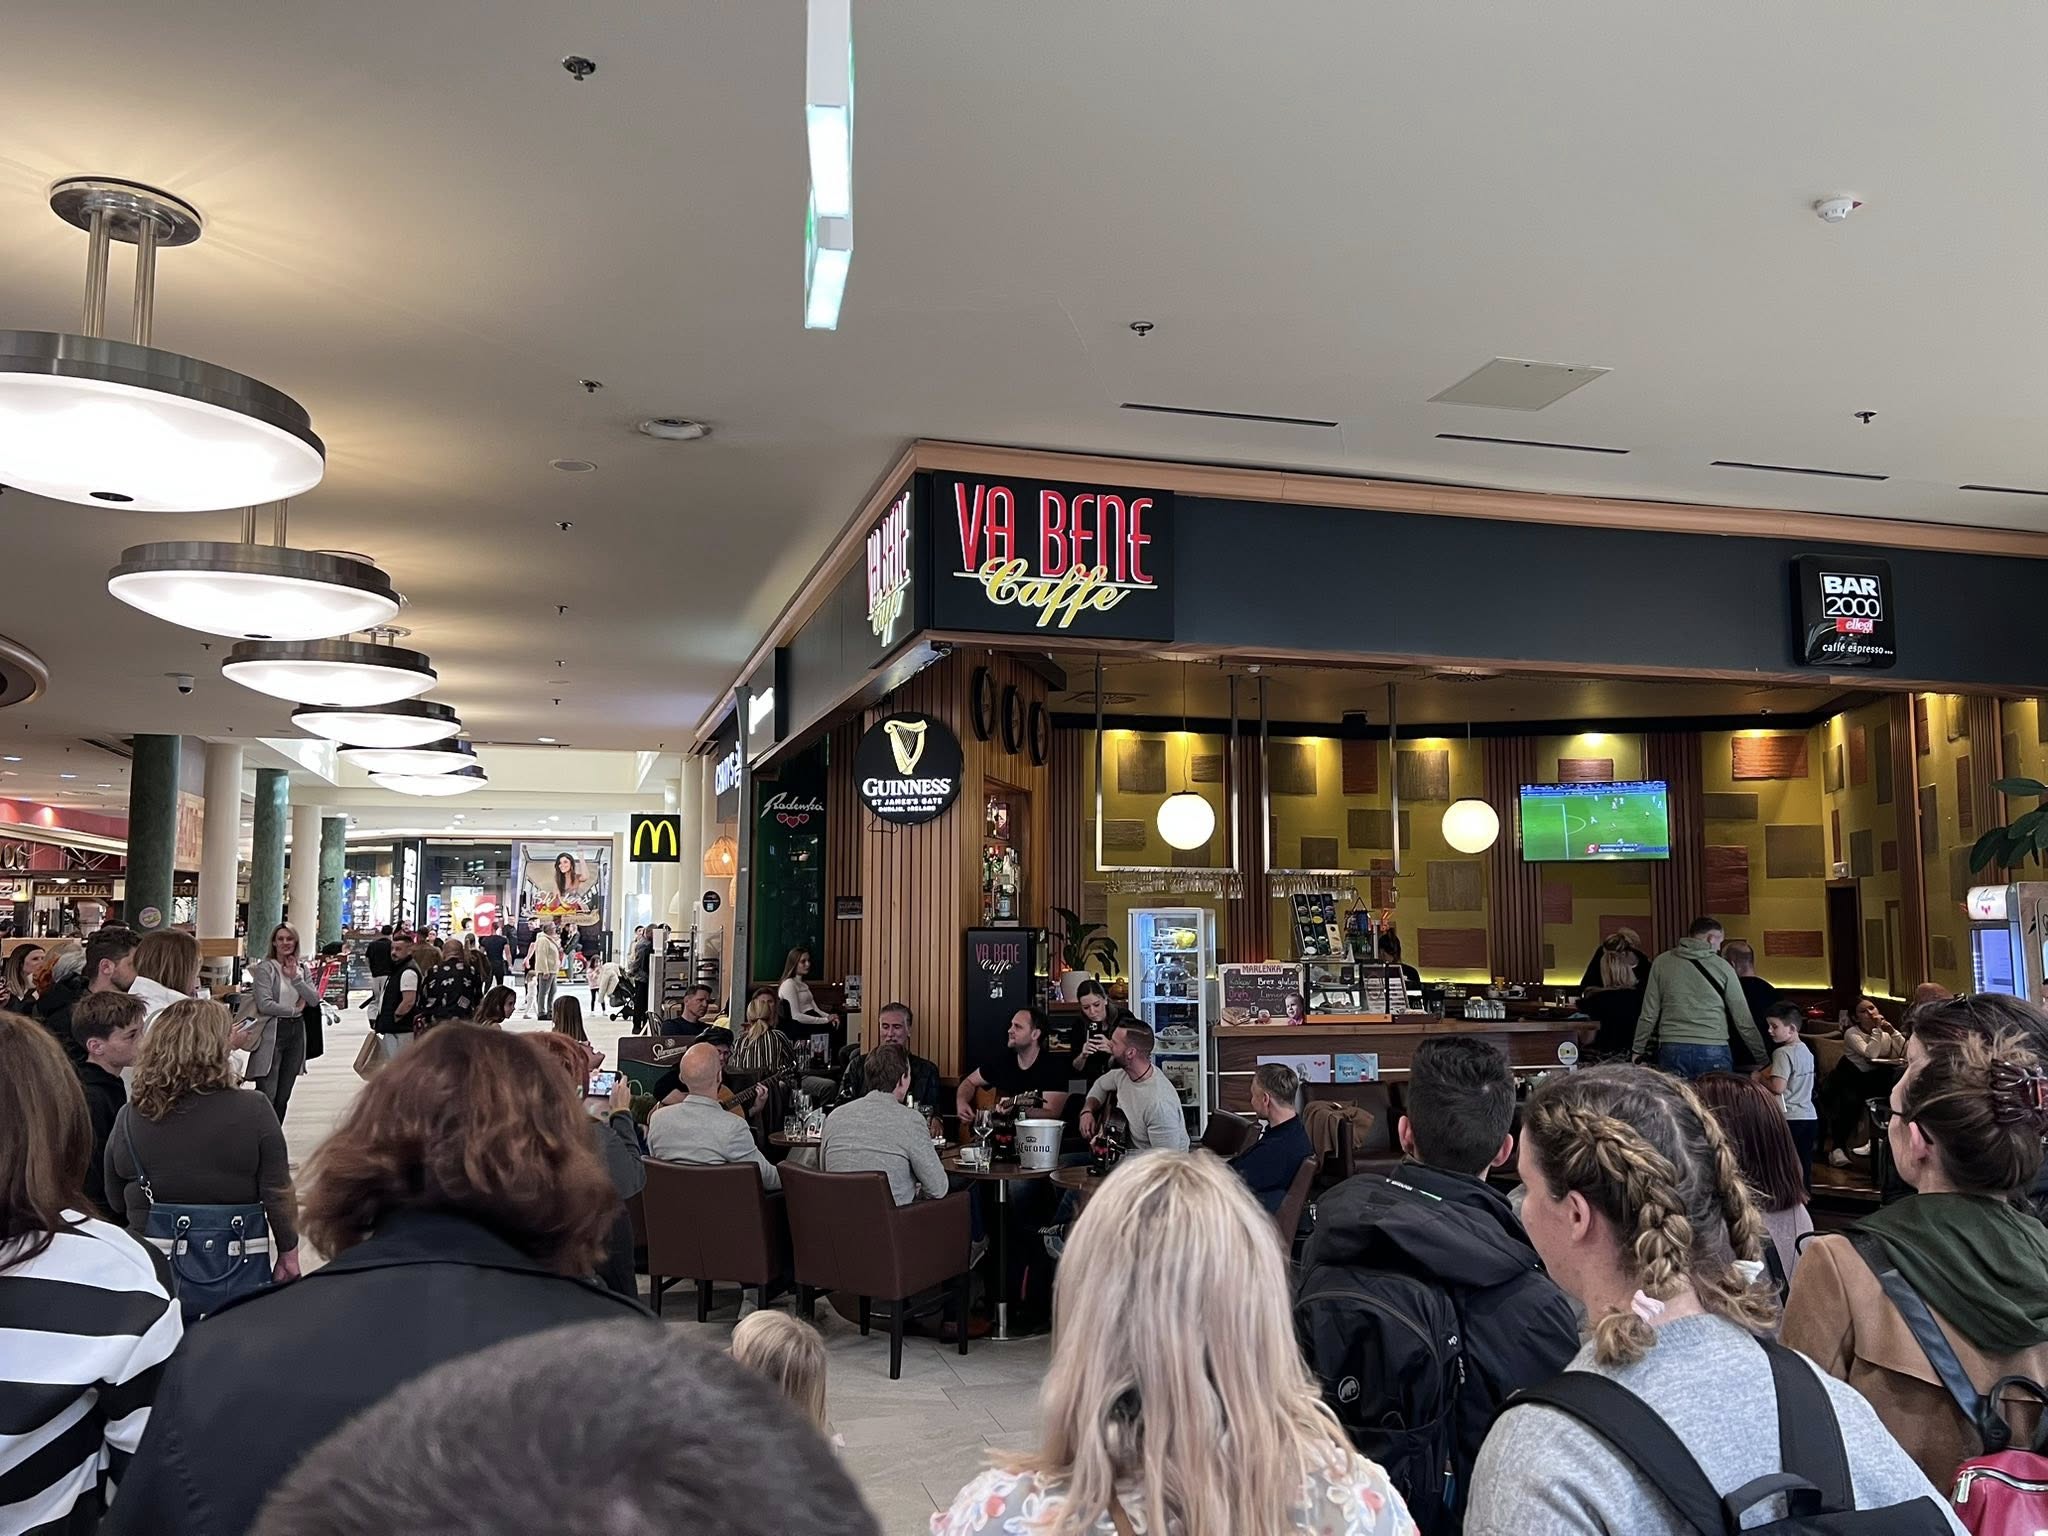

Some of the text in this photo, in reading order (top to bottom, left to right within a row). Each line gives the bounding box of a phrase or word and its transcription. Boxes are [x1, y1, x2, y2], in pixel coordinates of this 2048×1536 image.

[954, 482, 1153, 584] VA BENE
[978, 557, 1131, 628] Caffe
[1823, 576, 1878, 596] BAR
[1826, 597, 1880, 617] 2000
[862, 777, 952, 797] GUINNESS
[921, 797, 943, 805] GATE
[36, 884, 108, 896] PIZZERIJA
[975, 943, 1021, 964] VA BENE
